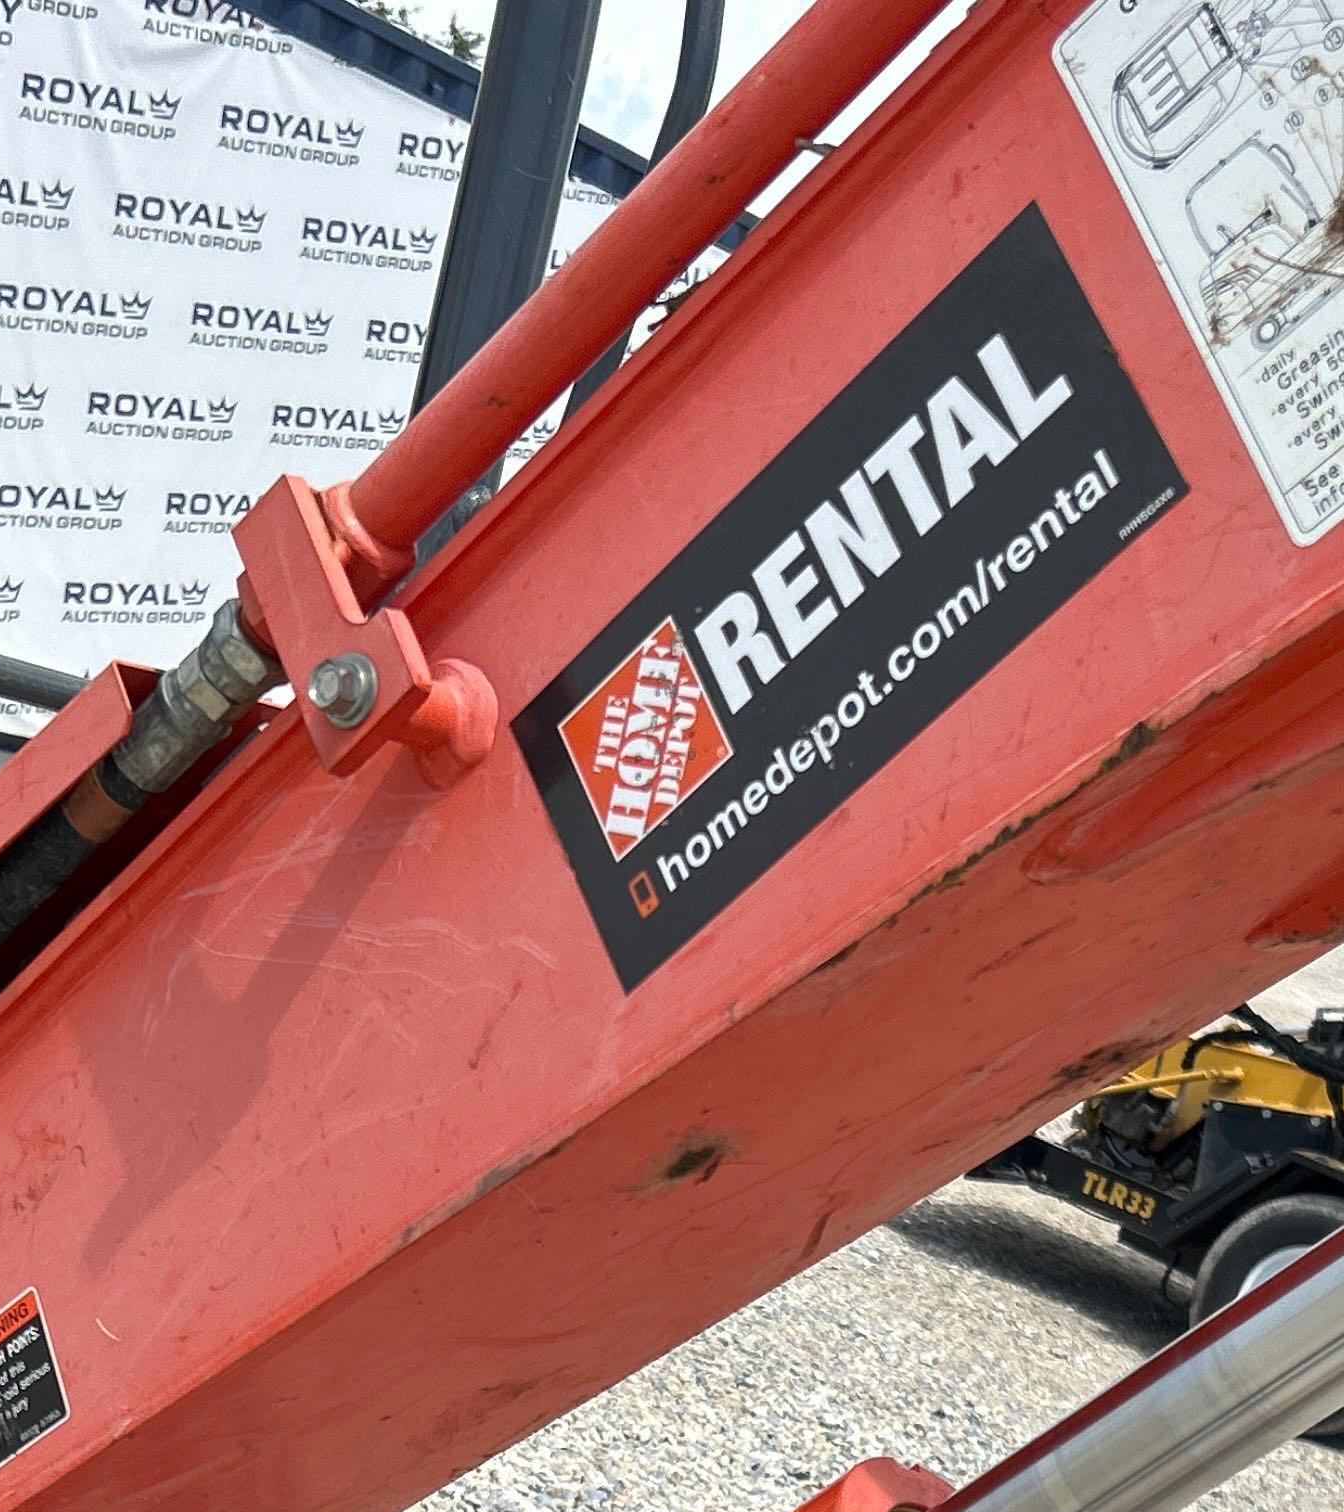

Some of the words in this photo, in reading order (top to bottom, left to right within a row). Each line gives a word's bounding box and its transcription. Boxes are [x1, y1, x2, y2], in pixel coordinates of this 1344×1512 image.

[143, 18, 227, 45] AUCTION
[228, 32, 294, 54] GROUP
[20, 72, 146, 117] ROYAL
[18, 105, 107, 133] AUCTION
[110, 119, 177, 141] GROUP
[220, 104, 333, 145] ROYAL
[217, 135, 298, 160] AUCTION
[299, 148, 360, 167] GROUP
[398, 132, 464, 164] ROY
[395, 162, 460, 182] AUCTIO
[0, 211, 70, 231] GROUP
[114, 191, 234, 230] ROYAL
[112, 223, 196, 246] AUCTION
[198, 232, 263, 253] GROUP
[301, 216, 407, 251] ROYAL
[299, 246, 374, 267] AUCTION
[375, 254, 433, 273] GROUP
[81, 320, 148, 340] GROUP
[191, 302, 302, 334] ROYAL
[366, 319, 427, 347] ROY
[189, 332, 266, 351] AUCTION
[269, 339, 328, 355] GROUP
[87, 390, 206, 422] ROYAL
[271, 404, 376, 433] ROYAL
[85, 420, 169, 440] AUCTION
[172, 422, 234, 442] GROUP
[269, 432, 343, 449] AUCTION
[1304, 464, 1340, 498] See
[165, 491, 251, 516] ROYA
[56, 515, 123, 531] GROUP
[693, 332, 1075, 716] RENTAL
[63, 581, 174, 606] ROYAL
[61, 609, 145, 625] AUCTION
[146, 610, 207, 625] GROUP
[655, 449, 1121, 892] homedepot.com/rental
[593, 695, 629, 773] THE
[607, 639, 684, 839] HOME
[654, 676, 702, 806] DEPOT
[1083, 1169, 1157, 1221] TLR33
